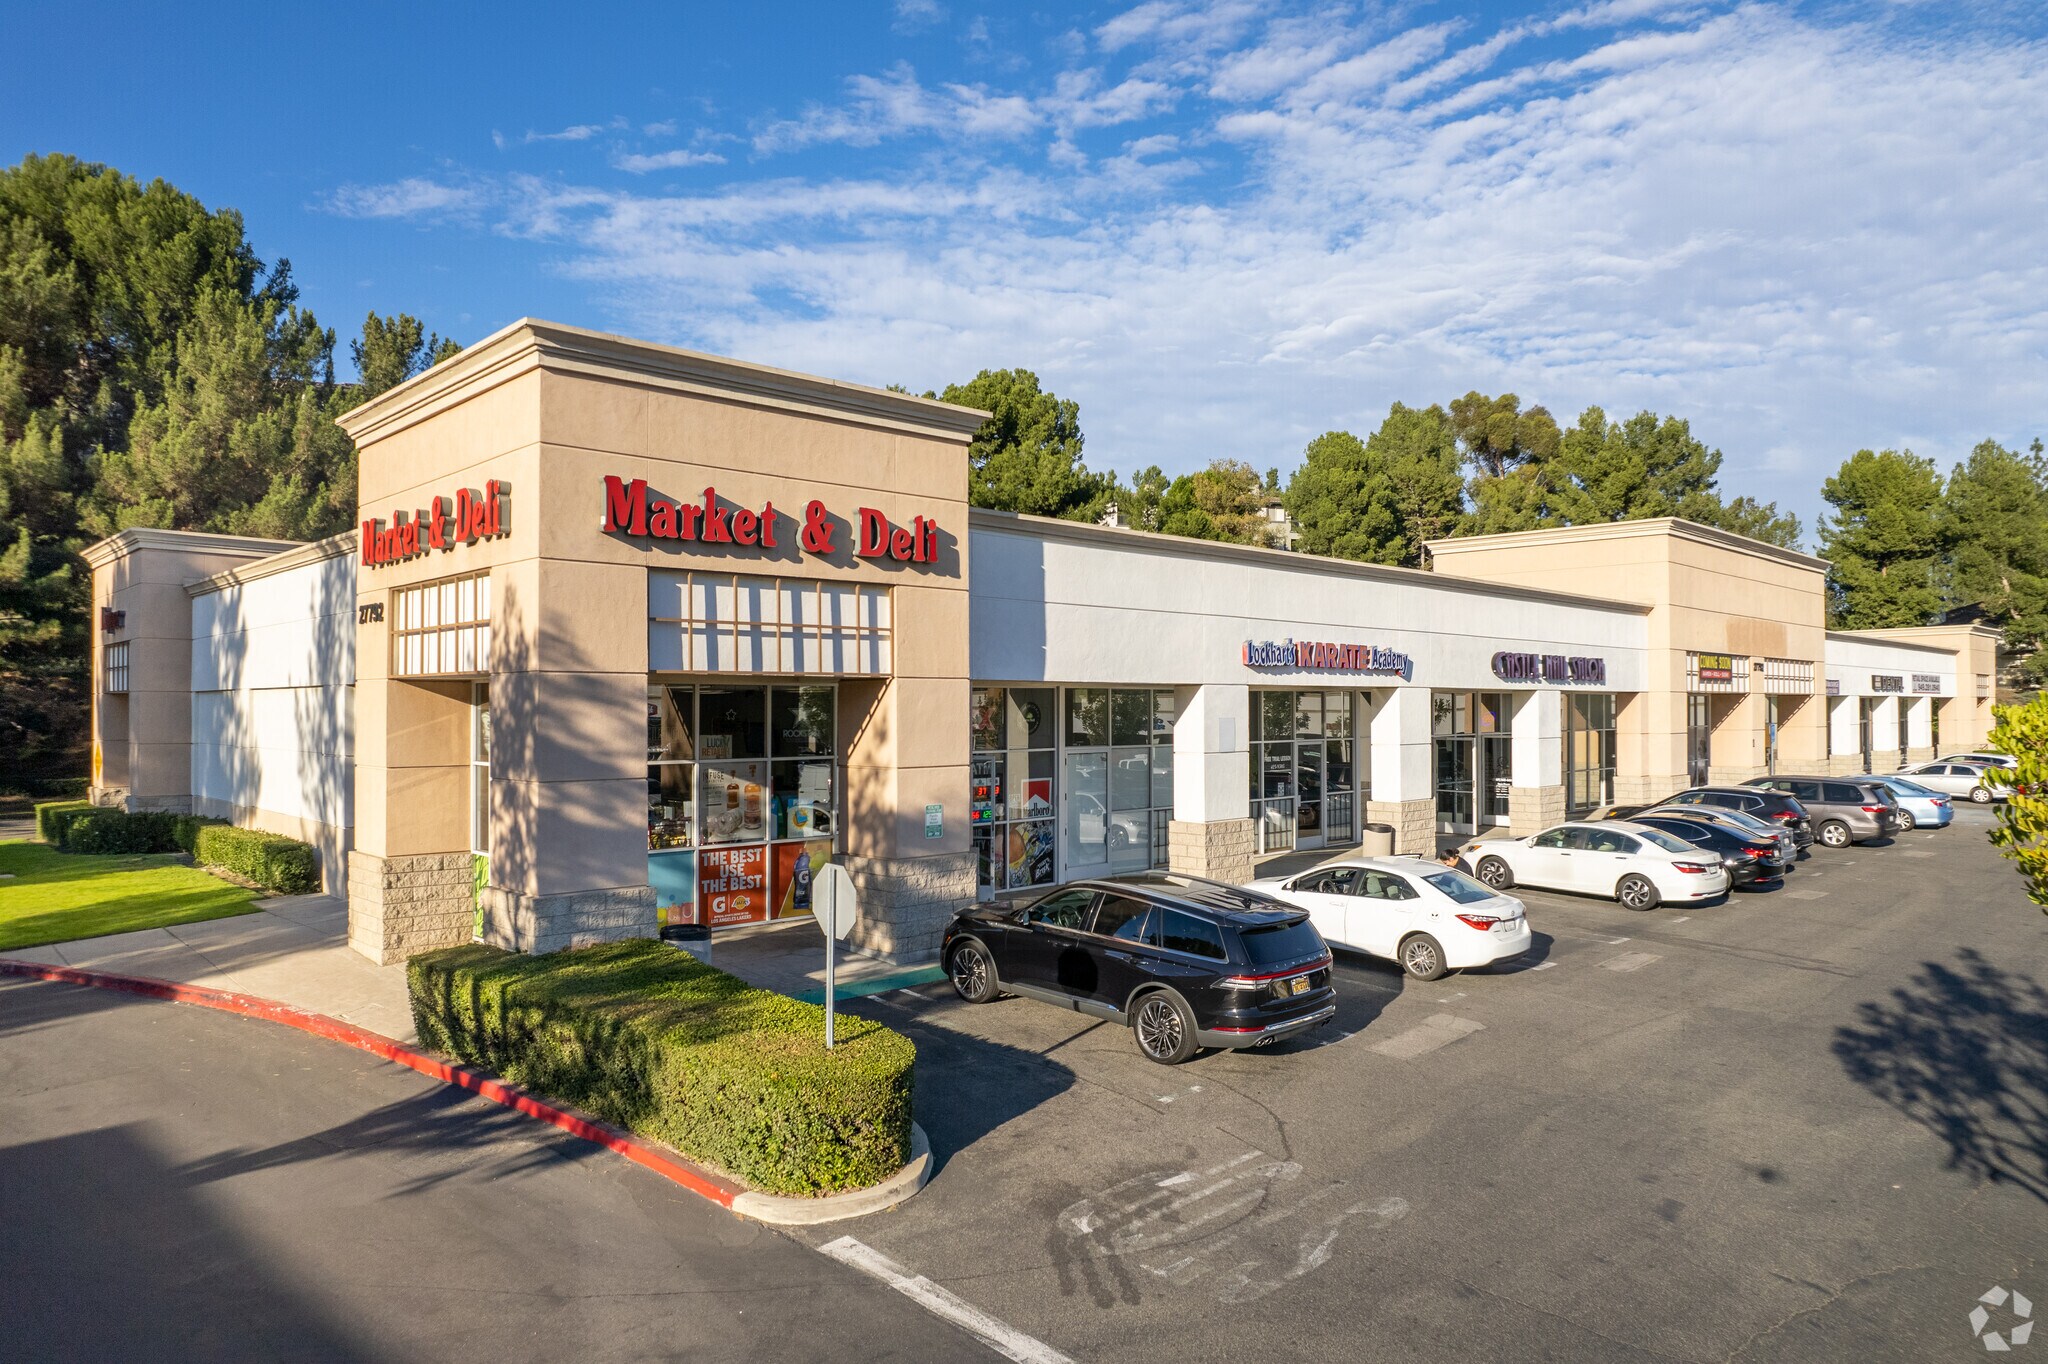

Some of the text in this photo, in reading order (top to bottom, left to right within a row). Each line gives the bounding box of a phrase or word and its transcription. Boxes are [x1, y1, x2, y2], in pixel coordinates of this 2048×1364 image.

[362, 479, 503, 567] Market & Deli
[602, 475, 938, 563] Market & Deli
[1247, 638, 1409, 676] Lockhart's KARATE Academy
[1700, 655, 1731, 670] COMING SOON
[702, 848, 762, 866] THE BEST
[720, 863, 745, 878] USE
[798, 870, 809, 884] G
[702, 875, 762, 894] THE BEST
[712, 896, 726, 913] G
